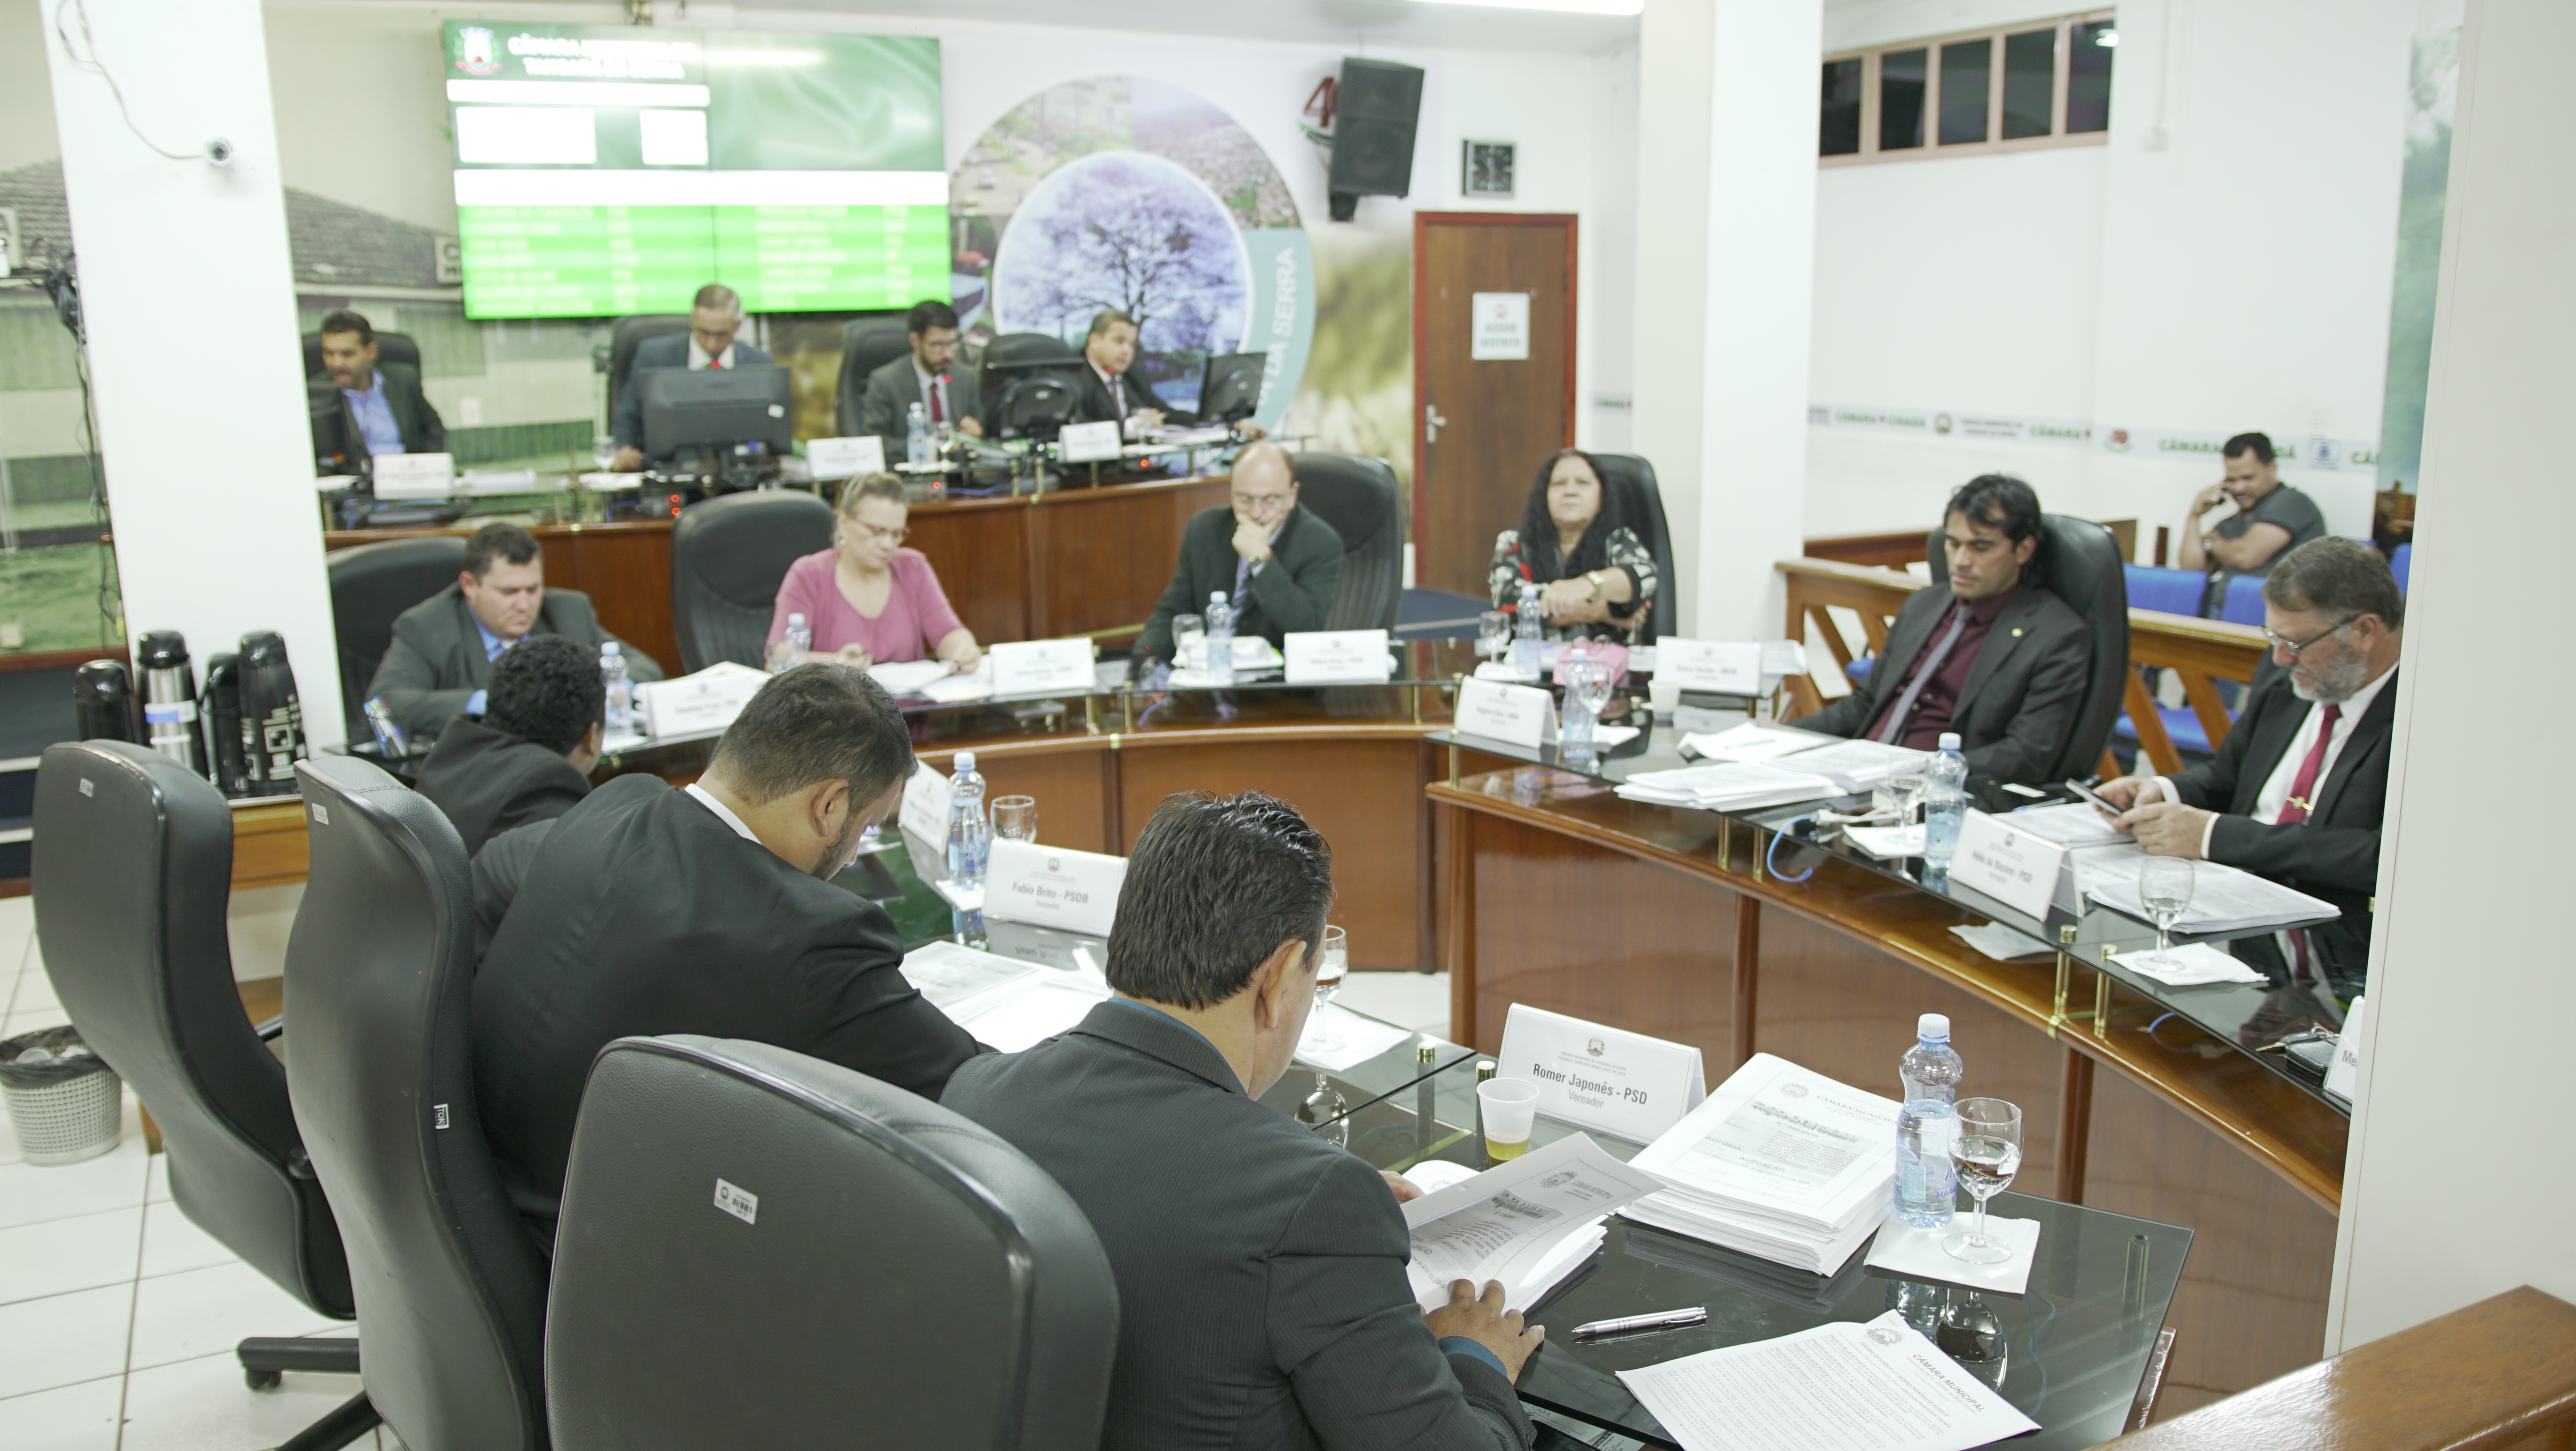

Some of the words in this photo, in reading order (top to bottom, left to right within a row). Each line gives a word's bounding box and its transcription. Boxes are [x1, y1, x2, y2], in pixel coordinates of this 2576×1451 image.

[1271, 246, 1297, 337] SERRA
[1012, 882, 1034, 895] Fabio
[1036, 886, 1056, 898] Brito
[1064, 890, 1088, 903] PSDB
[2342, 1049, 2357, 1068] Me
[1533, 1063, 1566, 1083] Romer
[1569, 1074, 1613, 1096] Japonês
[1623, 1087, 1647, 1105] PSD
[1569, 1090, 1604, 1108] Vereador
[1817, 1095, 1852, 1111] CÂMARA
[1739, 1156, 1785, 1172] AUTUAÇÃO
[1904, 1355, 1922, 1368] Tangará
[1923, 1371, 1936, 1380] Serra
[1934, 1381, 1950, 1392] Estado
[1951, 1395, 1964, 1404] Mato
[1913, 1353, 1945, 1381] CÂMARA
[1945, 1378, 1986, 1412] MUNICIPAL
[1900, 1386, 1919, 1402] VEREADOR
[1916, 1400, 1937, 1418] PROFESSOR
[1935, 1415, 1951, 1429] VAGNER
